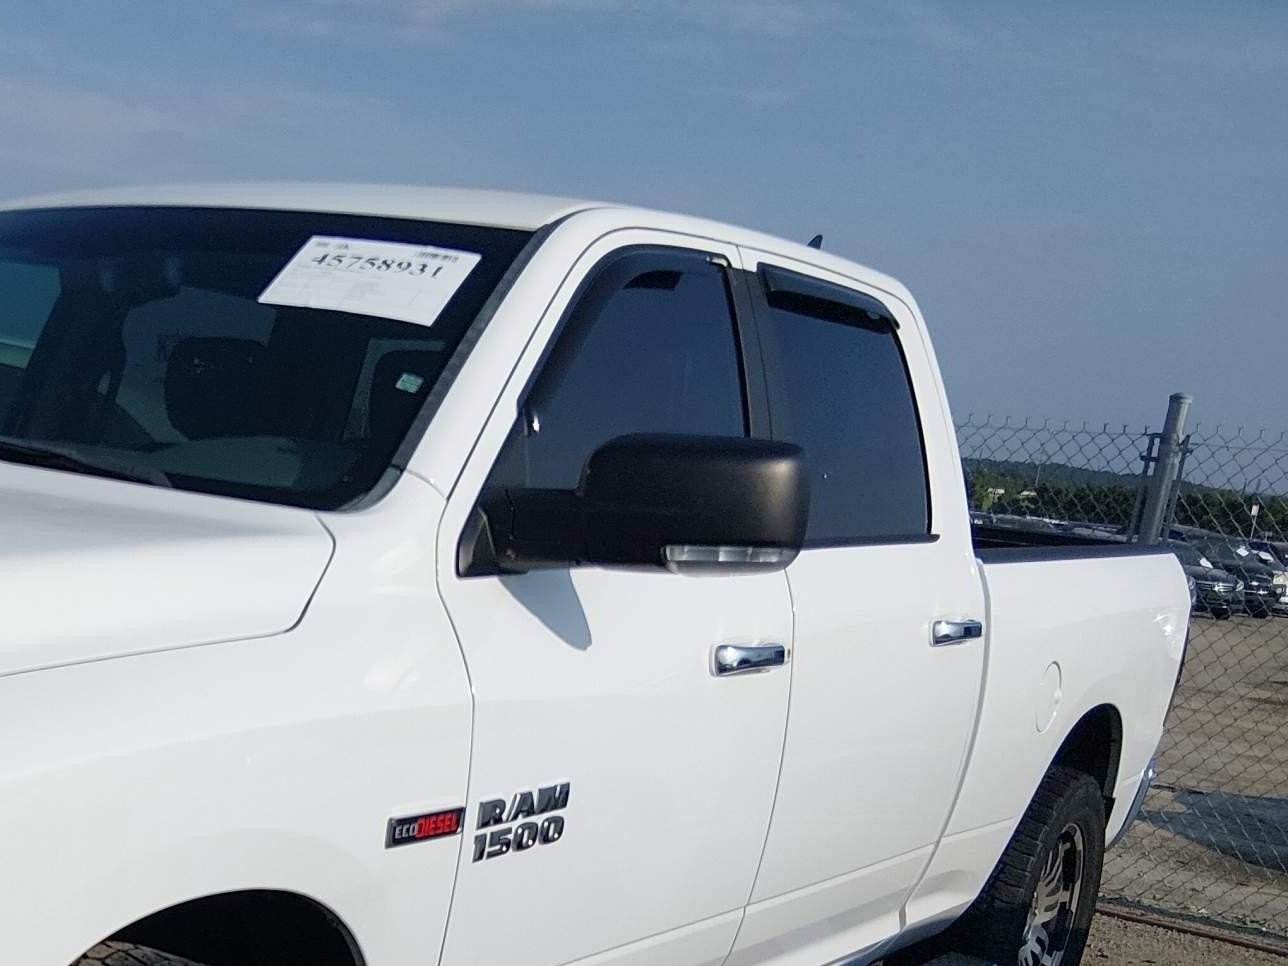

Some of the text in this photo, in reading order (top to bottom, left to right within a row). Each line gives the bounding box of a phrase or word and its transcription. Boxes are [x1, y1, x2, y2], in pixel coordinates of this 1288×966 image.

[312, 253, 443, 278] 45758931
[476, 782, 570, 830] RAM
[394, 812, 457, 839] ECODIESEL
[472, 816, 565, 863] 1500
